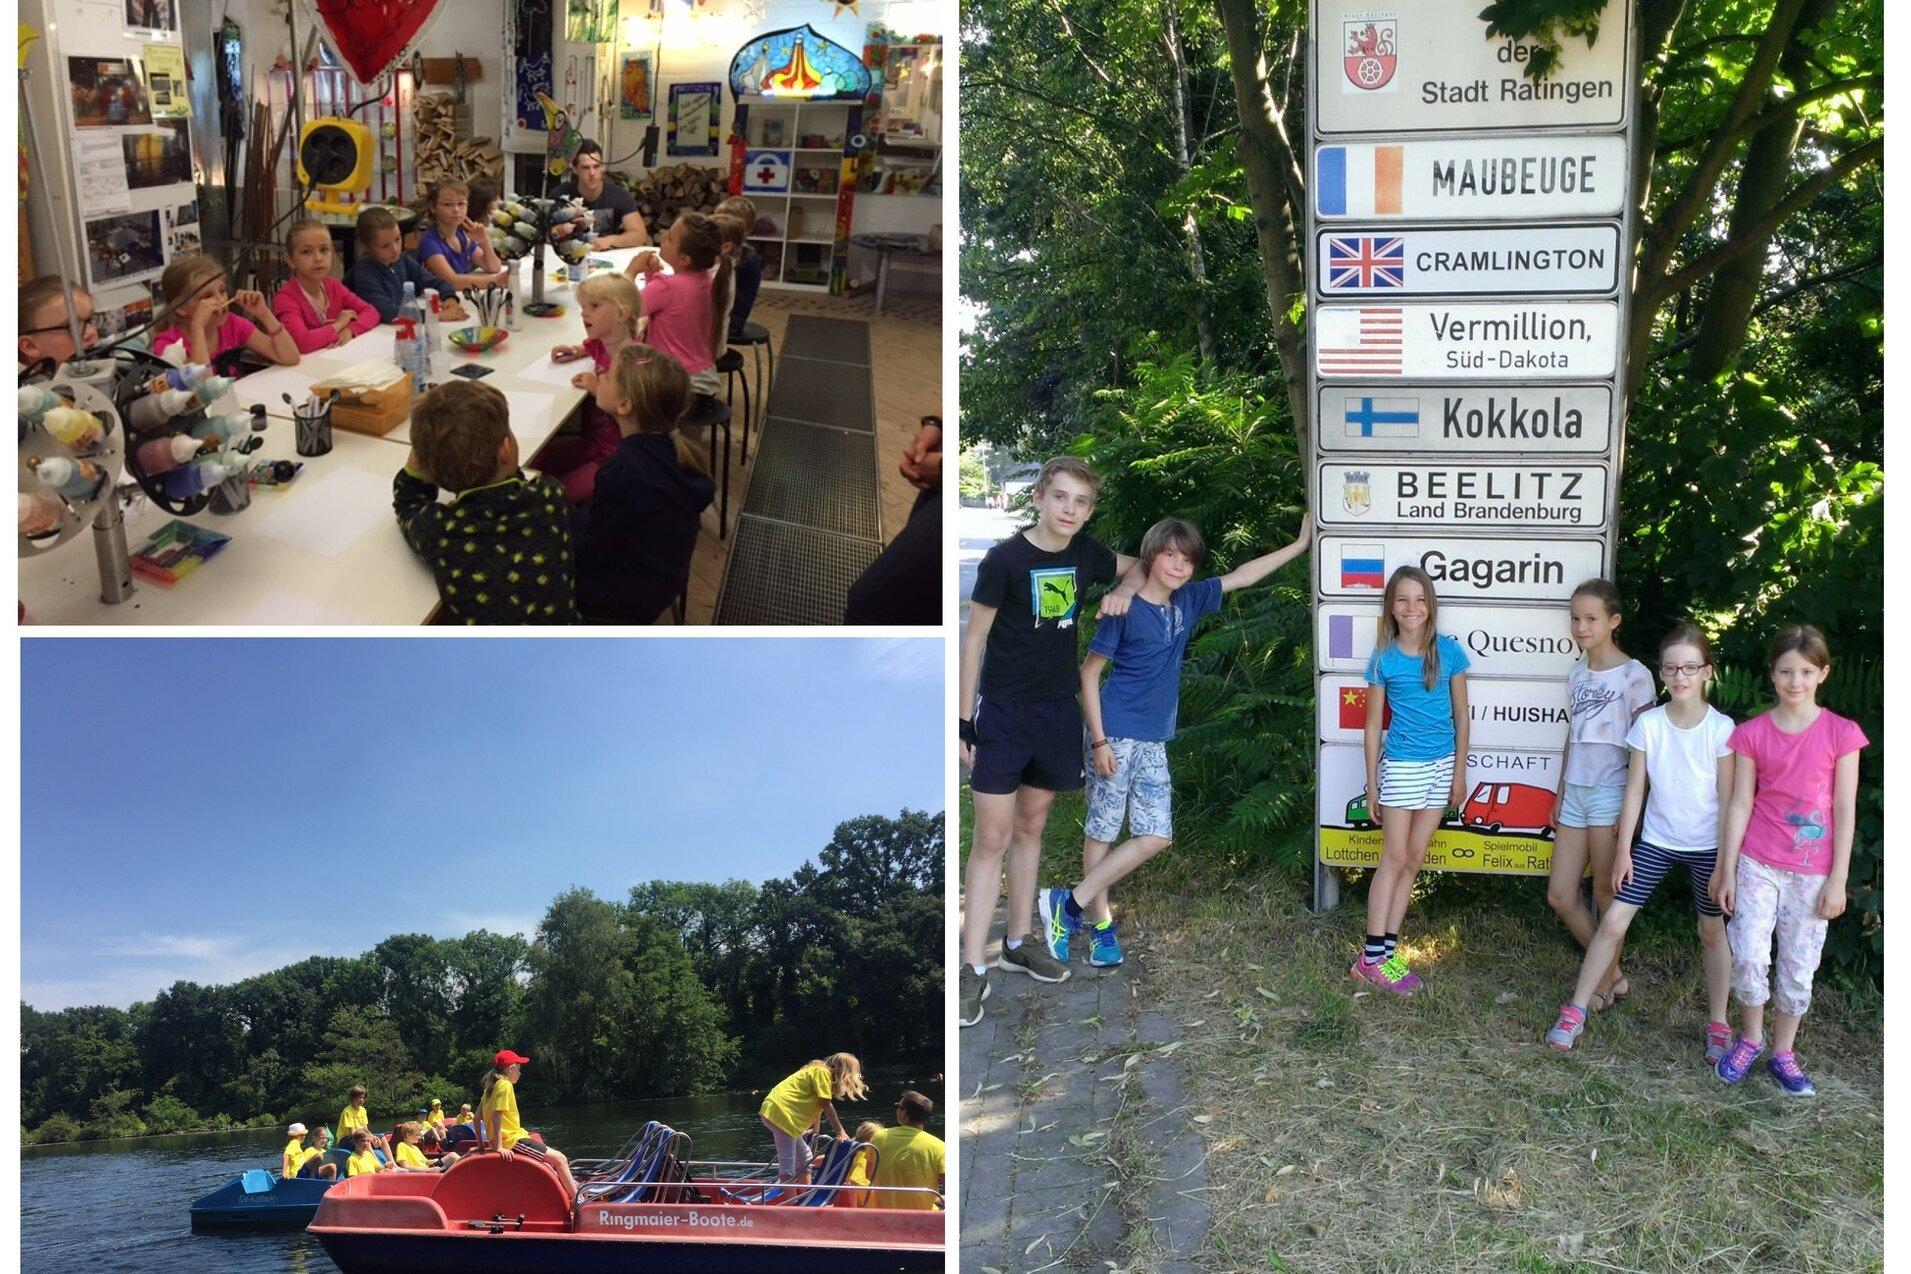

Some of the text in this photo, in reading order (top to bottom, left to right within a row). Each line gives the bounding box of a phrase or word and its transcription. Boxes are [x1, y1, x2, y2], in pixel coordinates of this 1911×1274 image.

[1497, 41, 1541, 63] der
[1421, 78, 1613, 104] Stadt Ratingen
[1432, 156, 1597, 197] MAUBEUGE
[1416, 249, 1604, 272] CRAMLINGTON
[1430, 312, 1591, 342] Vermillion,
[1447, 351, 1569, 369] Süd-Dakota
[1443, 397, 1582, 438] Kokkola
[1397, 472, 1582, 500] BEELITZ
[1397, 502, 1582, 523] Land Brandenburg
[1420, 550, 1564, 589] Gagarin
[1494, 706, 1570, 723] HUISHA
[1466, 755, 1551, 770] SCHAFT
[1326, 847, 1379, 861] Lottchen
[1428, 840, 1447, 848] ahn
[1484, 841, 1537, 852] Spielmobil
[1424, 853, 1447, 864] den
[1483, 854, 1513, 868] Felix
[600, 1210, 753, 1229] Ringmaier-Boote.de
